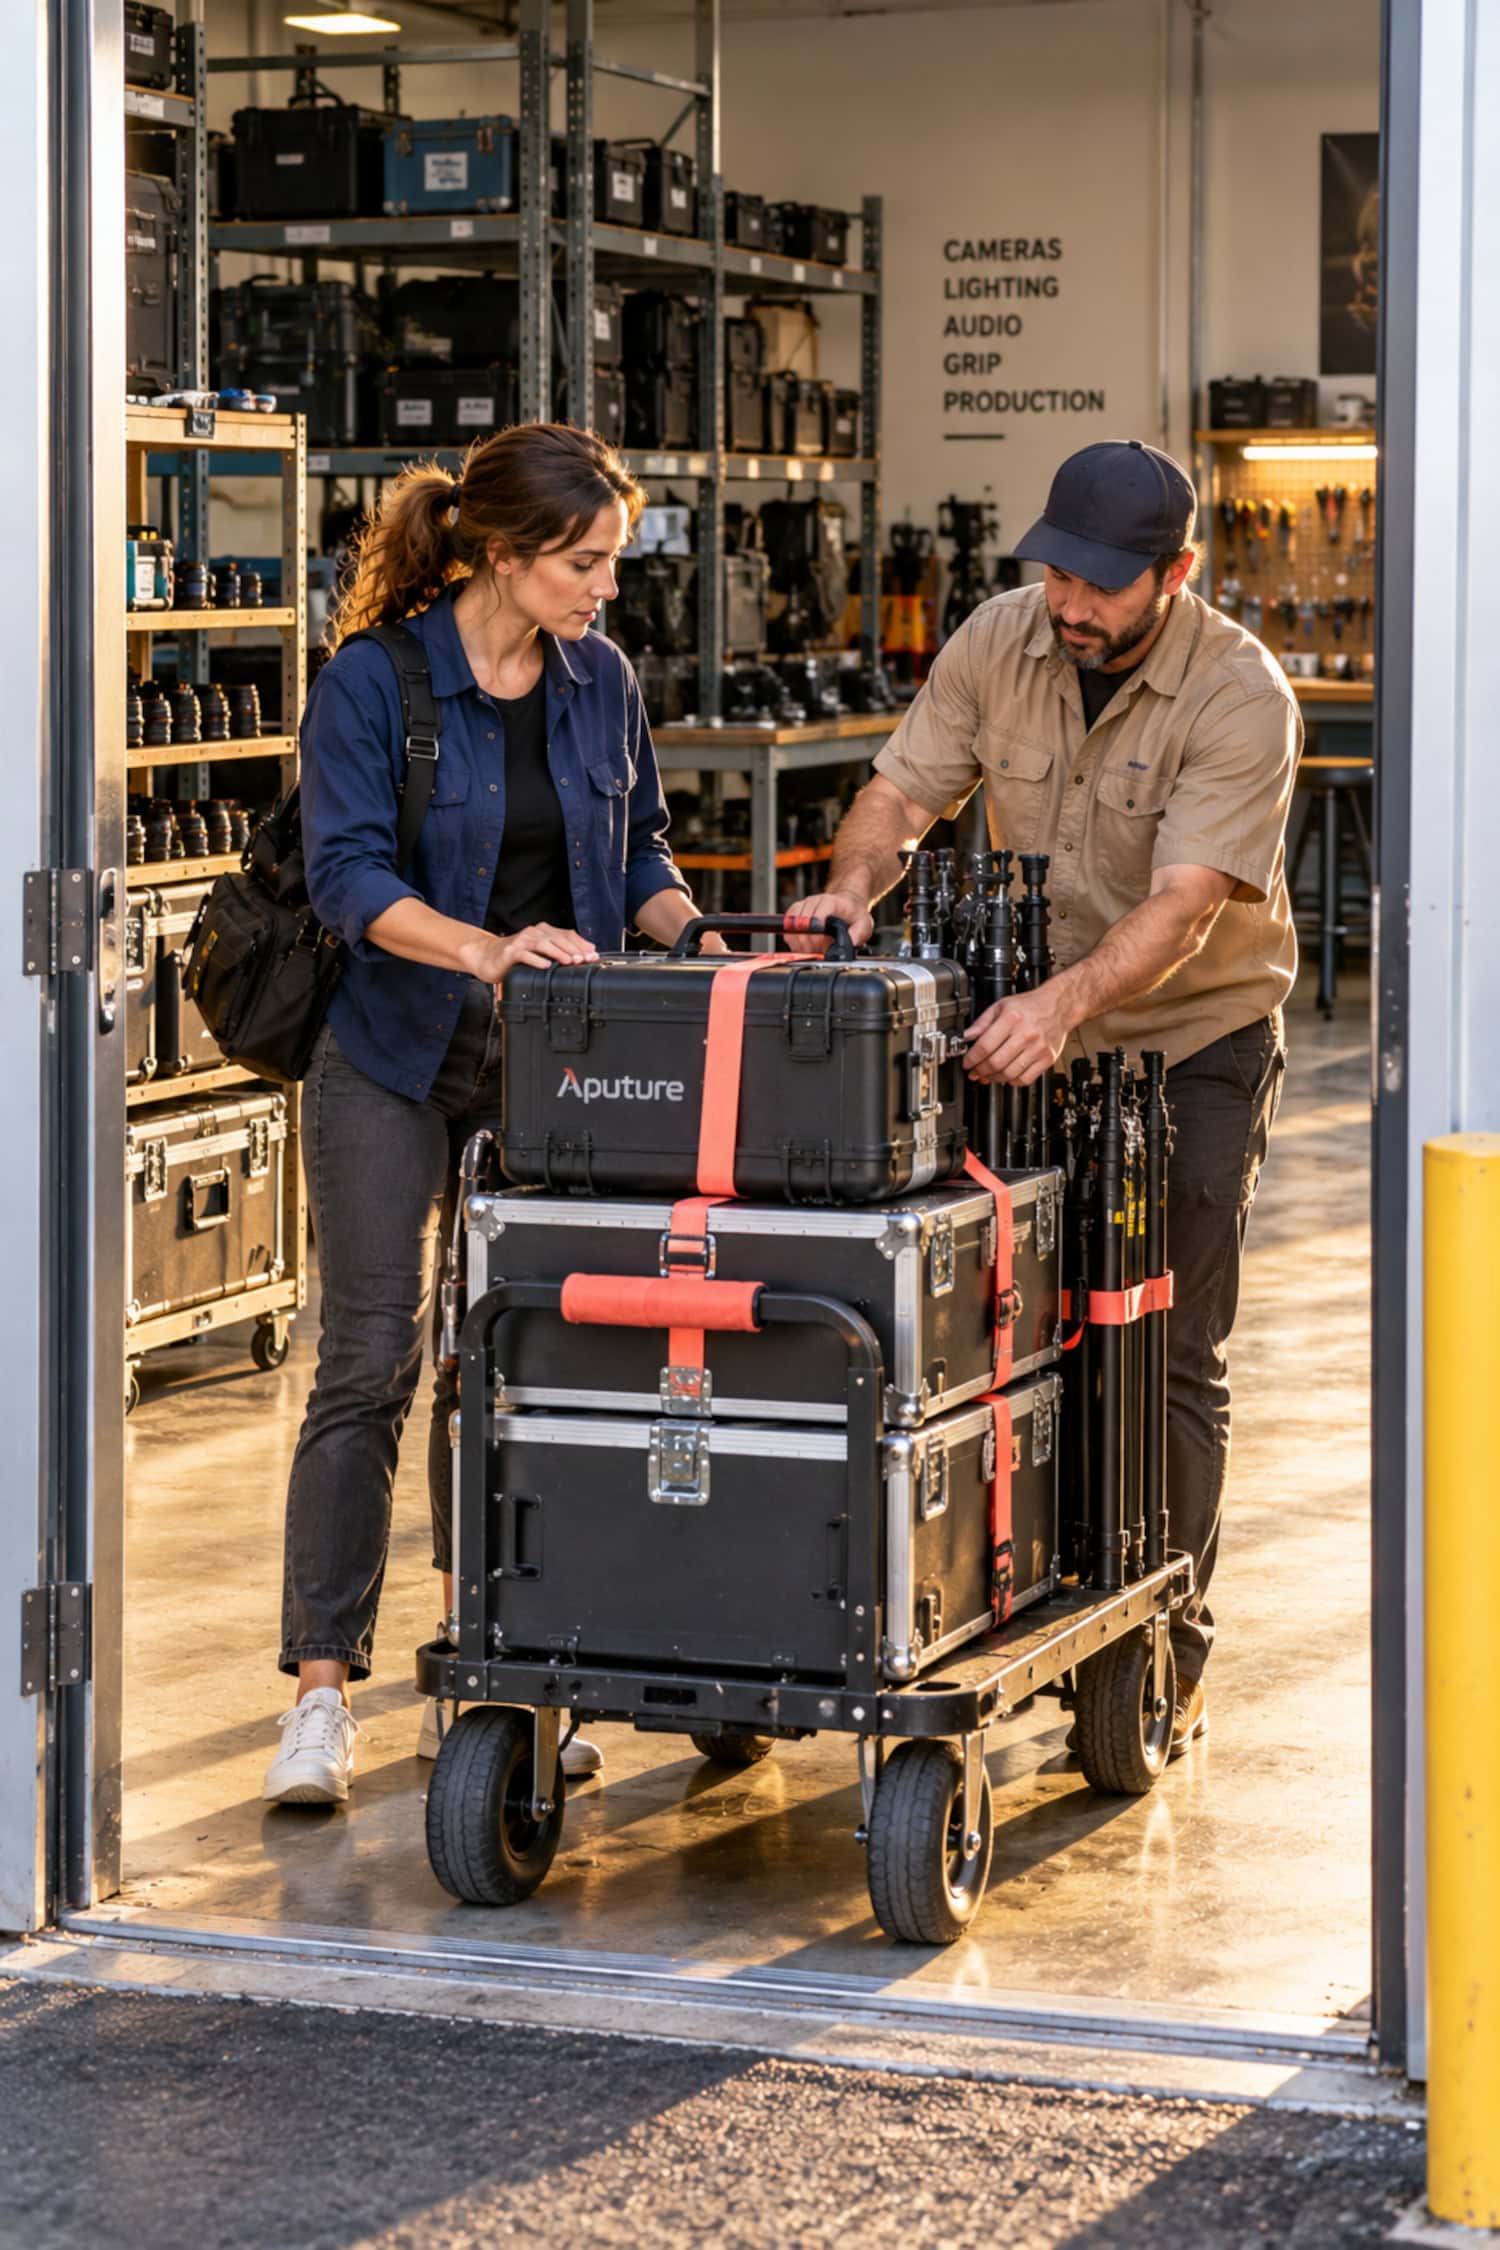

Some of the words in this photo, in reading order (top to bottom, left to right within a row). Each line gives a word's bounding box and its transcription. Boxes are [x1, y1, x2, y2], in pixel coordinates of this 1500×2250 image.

[943, 238, 1062, 263] CAMERAS
[943, 275, 1059, 300] LIGHTING
[943, 314, 1023, 338] AUDIO
[943, 352, 1002, 376] GRIP
[943, 389, 1105, 414] PRODUCTION
[556, 1066, 685, 1104] Aputure
